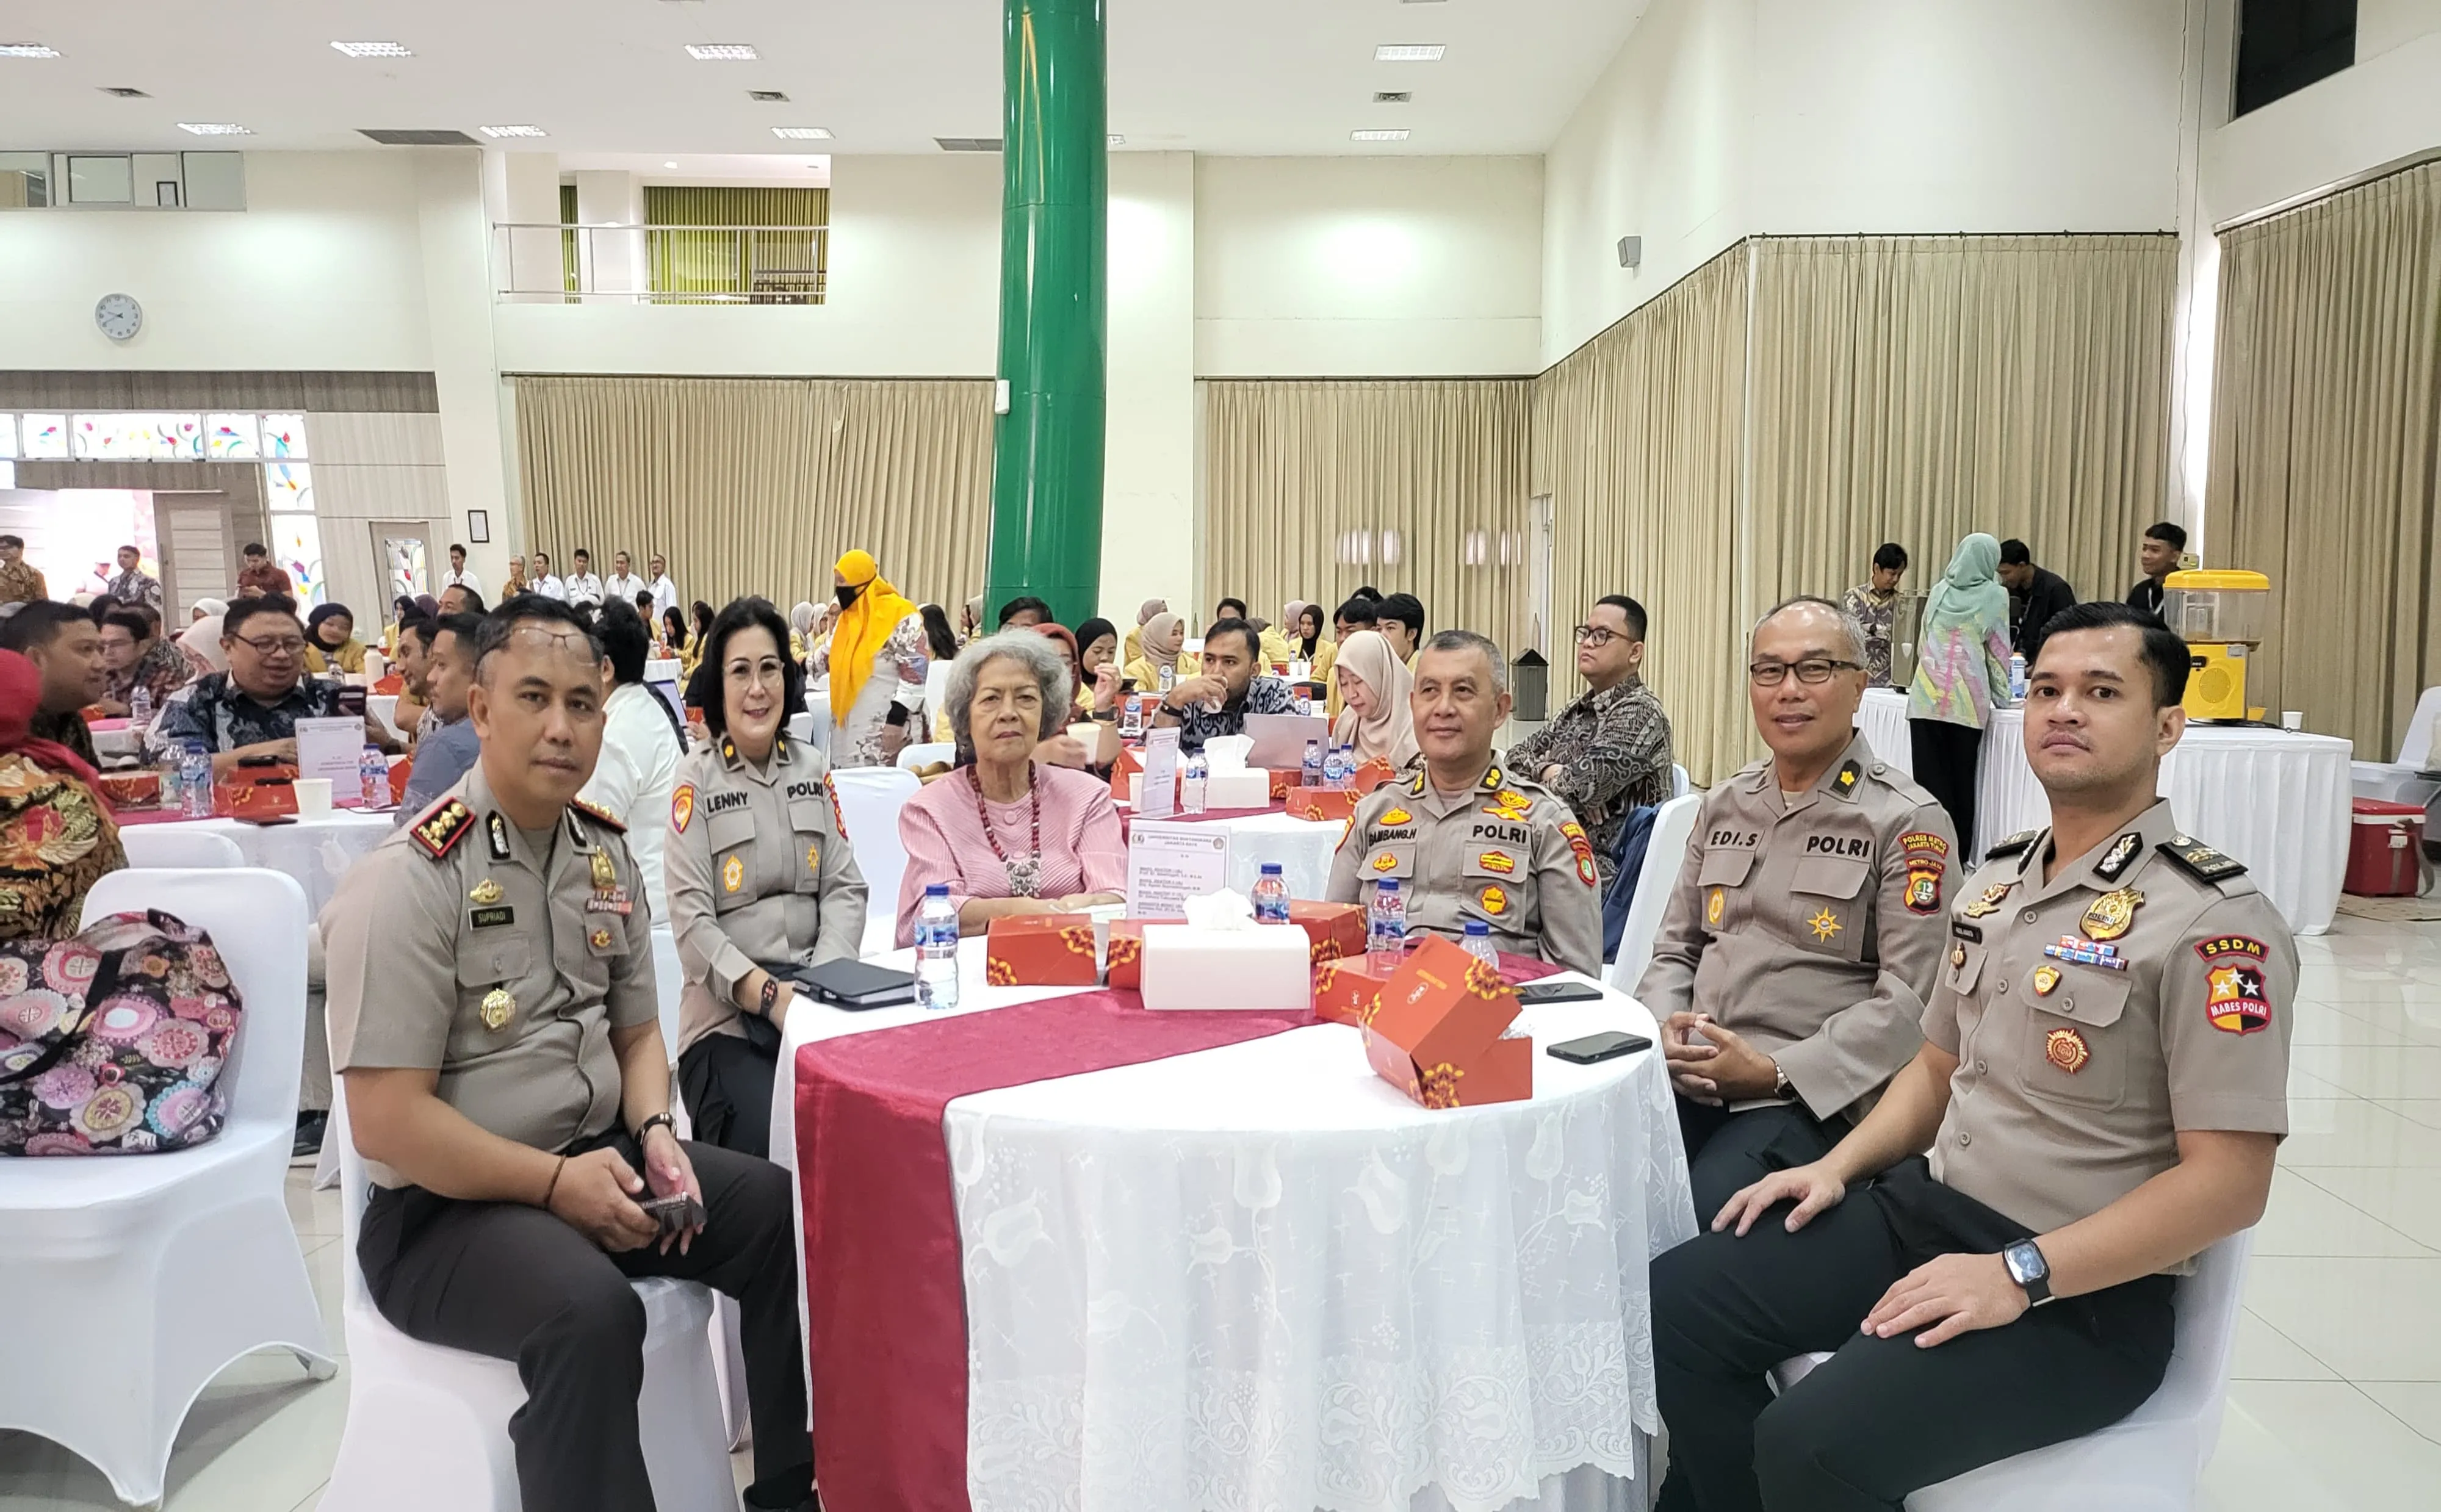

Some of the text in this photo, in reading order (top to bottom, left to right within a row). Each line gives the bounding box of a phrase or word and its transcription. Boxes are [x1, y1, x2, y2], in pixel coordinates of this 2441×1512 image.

[787, 781, 823, 798] POLRI
[707, 792, 748, 813] LENNY
[1473, 825, 1526, 843] POLRI
[1711, 831, 1758, 846] EDI.S
[1903, 834, 1947, 850] POLRES METRO
[1806, 836, 1870, 857] POLRI
[1908, 841, 1930, 851] JAKARTA
[478, 910, 506, 923] SUPRIADI
[2088, 912, 2114, 924] POLISI
[2206, 938, 2260, 956] SSDM
[2210, 1001, 2267, 1017] MABES POLRI
